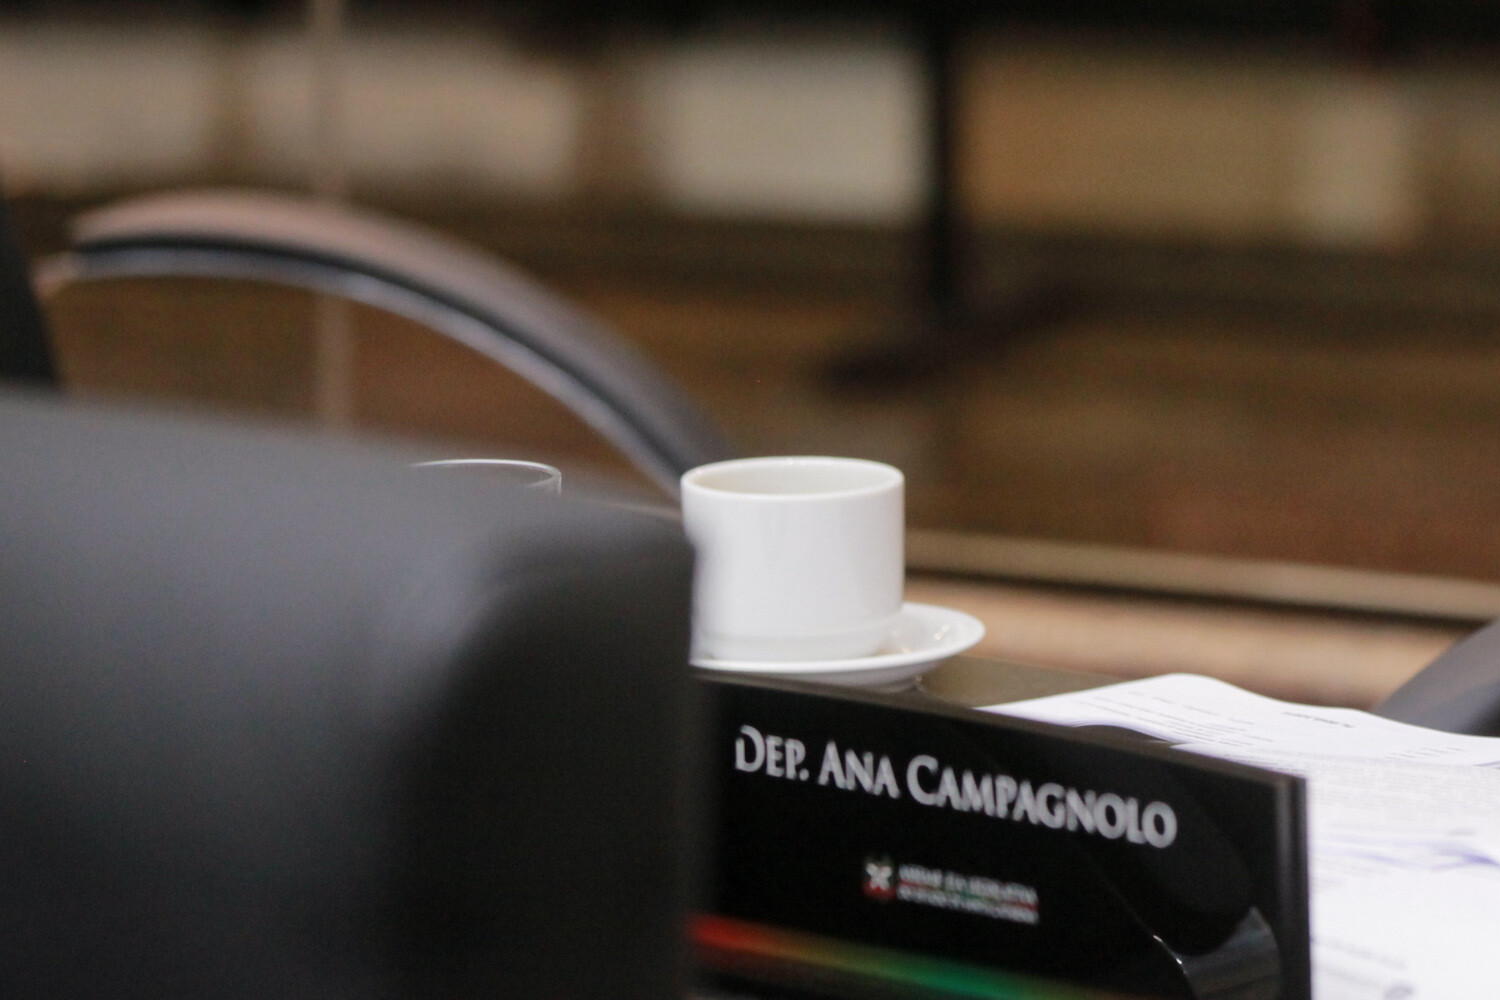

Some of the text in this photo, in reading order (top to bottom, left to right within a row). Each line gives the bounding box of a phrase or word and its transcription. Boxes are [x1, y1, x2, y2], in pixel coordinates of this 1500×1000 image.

[734, 725, 1178, 848] DEP. ANA CAMPAGNOLO
